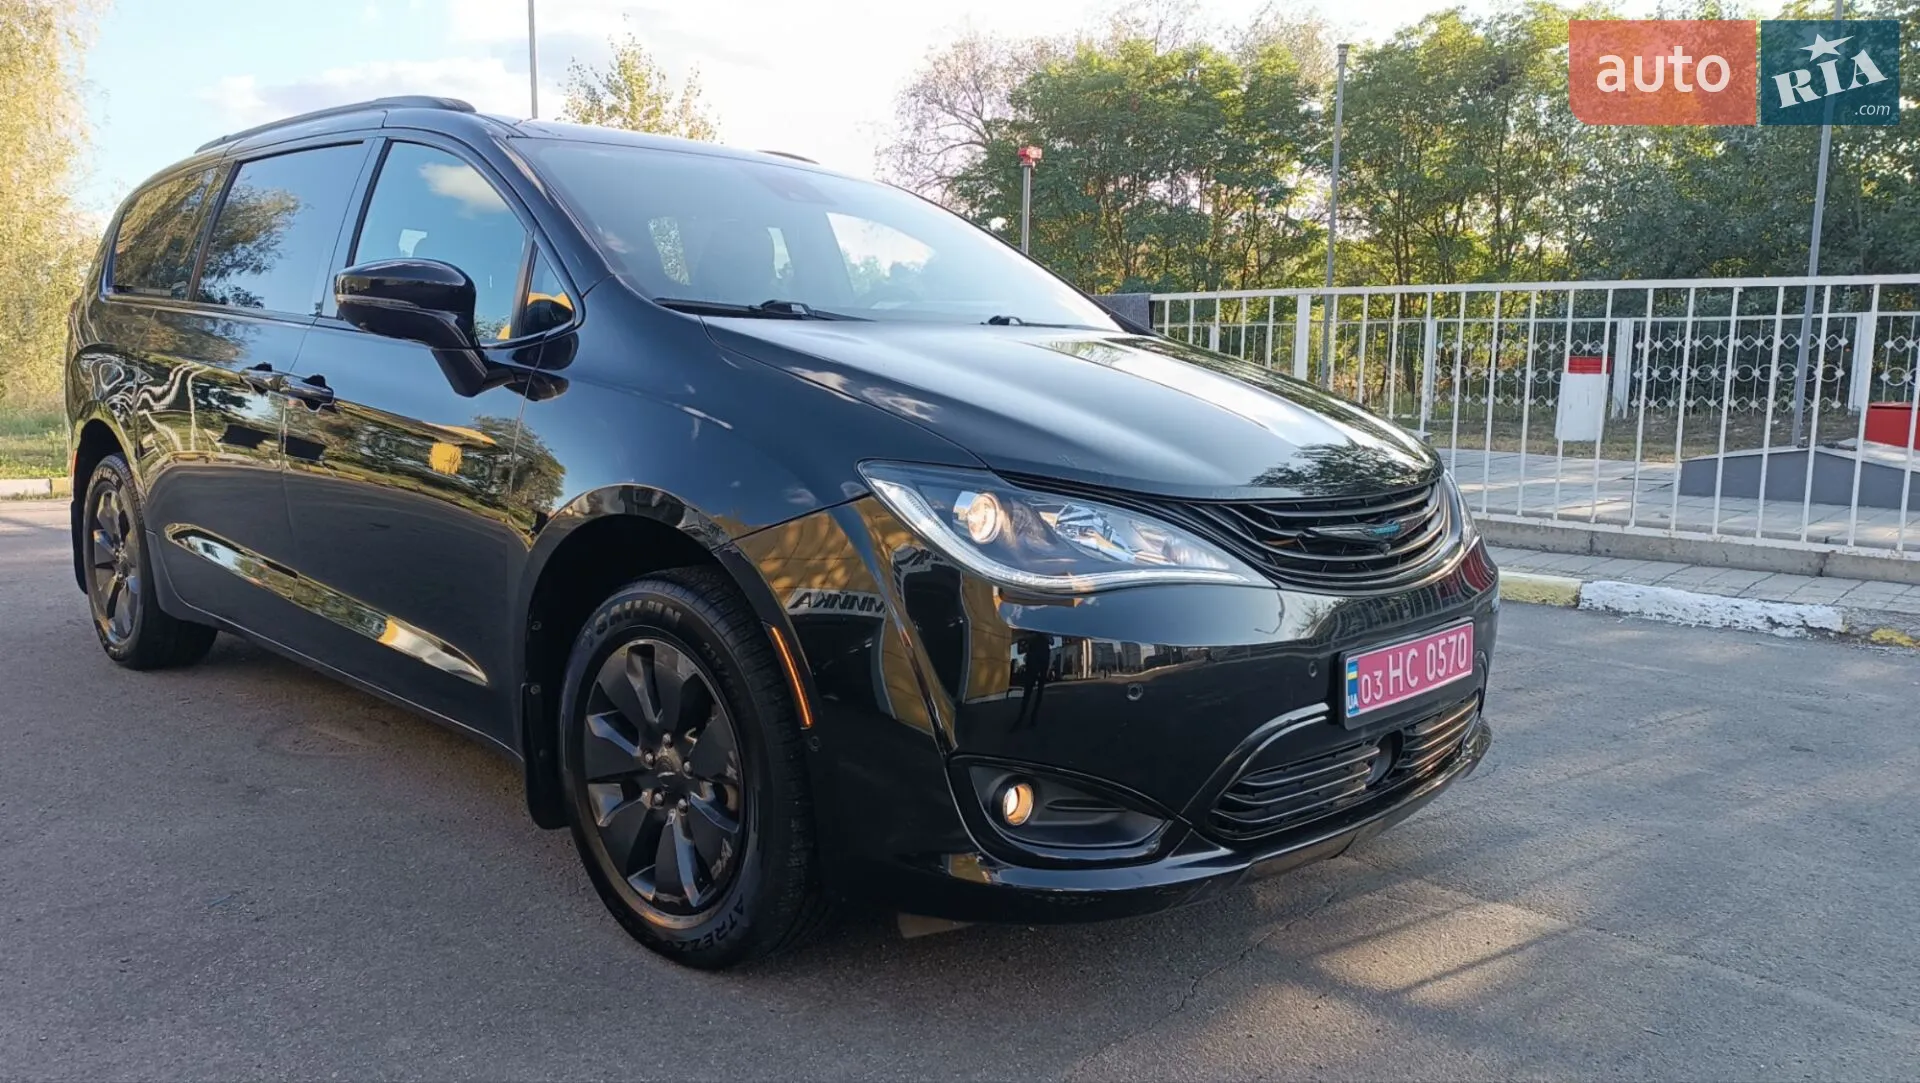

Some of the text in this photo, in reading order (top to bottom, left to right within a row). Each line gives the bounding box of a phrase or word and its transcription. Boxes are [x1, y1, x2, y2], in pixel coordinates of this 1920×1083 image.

[1361, 632, 1467, 704] 03 HC 0570
[1348, 693, 1359, 709] UA
